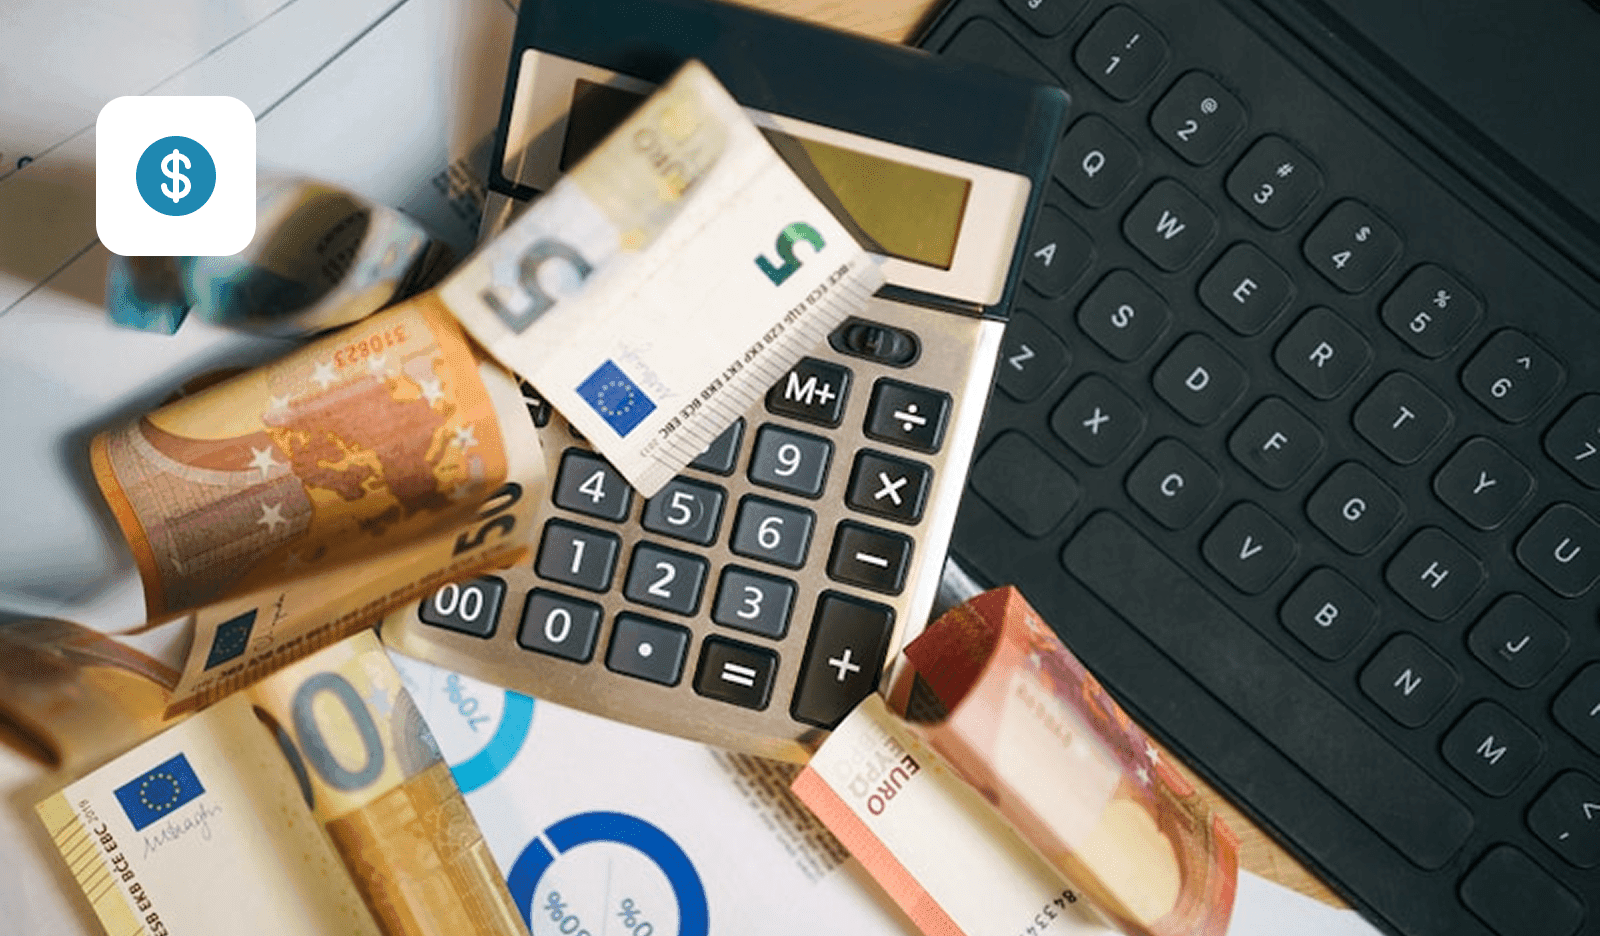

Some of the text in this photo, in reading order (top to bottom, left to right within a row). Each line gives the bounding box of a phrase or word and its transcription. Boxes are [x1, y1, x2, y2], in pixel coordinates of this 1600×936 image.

[1125, 34, 1140, 49] !
[1105, 56, 1121, 75] 1
[1200, 97, 1218, 114] @
[1176, 119, 1198, 142] 2
[1082, 150, 1106, 178] Q
[1276, 163, 1294, 178] #
[1253, 183, 1274, 205] 3
[1156, 210, 1186, 240] W
[1355, 226, 1371, 242] $
[754, 222, 827, 287] 5
[1033, 242, 1057, 267] A
[1331, 250, 1352, 269] 4
[480, 237, 594, 335] 5
[1232, 278, 1258, 304] E
[1433, 290, 1451, 309] %
[1110, 304, 1135, 329] S
[1409, 311, 1432, 333] 5
[1008, 344, 1035, 371] Z
[1308, 341, 1334, 368] R
[700, 378, 724, 401] EKB
[785, 373, 836, 404] M+
[1185, 366, 1210, 391] D
[1491, 377, 1512, 398] 6
[658, 416, 683, 440] EBC
[1082, 407, 1110, 435] X
[1392, 406, 1415, 429] T
[1263, 431, 1288, 453] F
[1575, 442, 1597, 460] 7
[774, 443, 801, 476] 9
[579, 471, 606, 505] 4
[1160, 473, 1184, 497] C
[1473, 471, 1496, 494] Y
[453, 482, 524, 558] 50
[667, 491, 694, 525] 5
[1342, 497, 1366, 521] G
[757, 516, 784, 549] 6
[571, 539, 586, 574] 1
[1239, 535, 1263, 560] V
[1554, 537, 1581, 563] U
[648, 562, 676, 598] 2
[1420, 561, 1449, 589] H
[434, 583, 483, 621] 00
[736, 586, 764, 619] 3
[1314, 602, 1339, 627] B
[544, 608, 571, 643] 0
[1506, 636, 1530, 653] J
[1394, 668, 1422, 696] N
[443, 673, 490, 732] 70%
[1476, 735, 1507, 765] M
[867, 754, 921, 816] EURO
[93, 823, 118, 853] EBC
[128, 882, 153, 913] EKB
